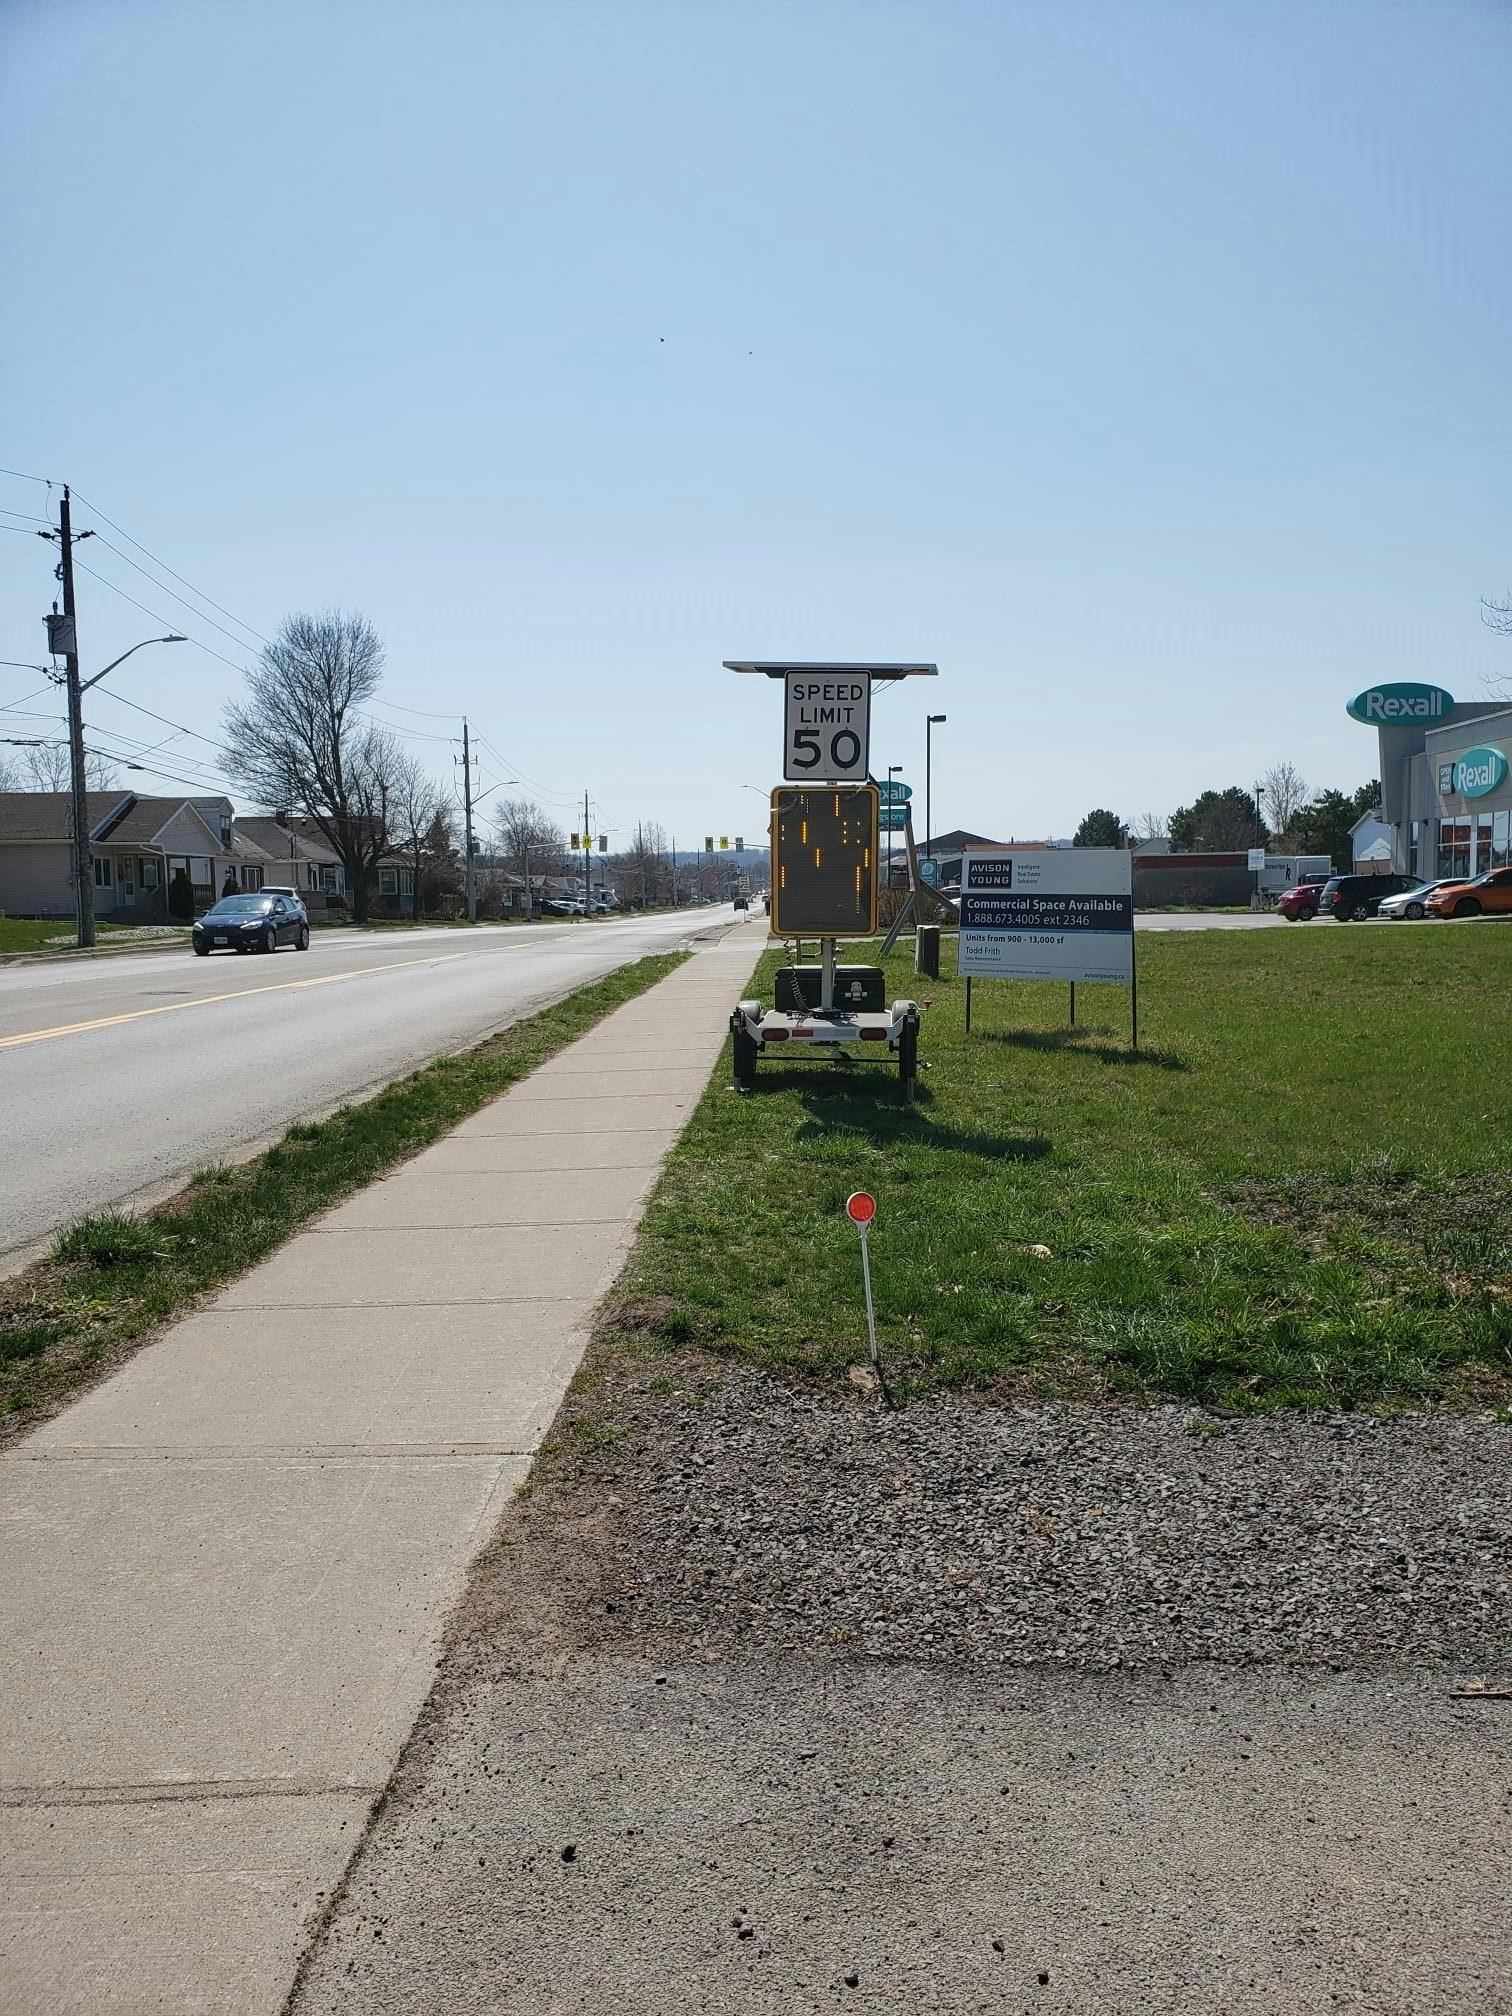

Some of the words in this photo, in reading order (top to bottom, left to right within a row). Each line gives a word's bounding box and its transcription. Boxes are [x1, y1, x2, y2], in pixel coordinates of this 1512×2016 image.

[793, 684, 863, 701] SPEED
[1366, 691, 1442, 720] Rexall
[800, 707, 855, 723] LIMIT
[792, 729, 861, 768] 50
[1458, 756, 1496, 792] Rexall
[971, 864, 1010, 872] AVISON
[971, 876, 1009, 884] YOUNG
[967, 898, 1030, 910] Commercial
[1033, 899, 1066, 913] Space
[1068, 899, 1123, 911] Available
[967, 913, 1040, 924] 1.888.673.4005
[1043, 914, 1060, 925] ext
[1063, 914, 1090, 926] 2346
[966, 934, 986, 942] Units
[987, 934, 1006, 943] from
[1007, 935, 1022, 943] 900
[1029, 936, 1055, 944] 13,000
[1056, 936, 1065, 944] sf
[966, 946, 983, 955] Todd
[984, 946, 1001, 955] Frith
